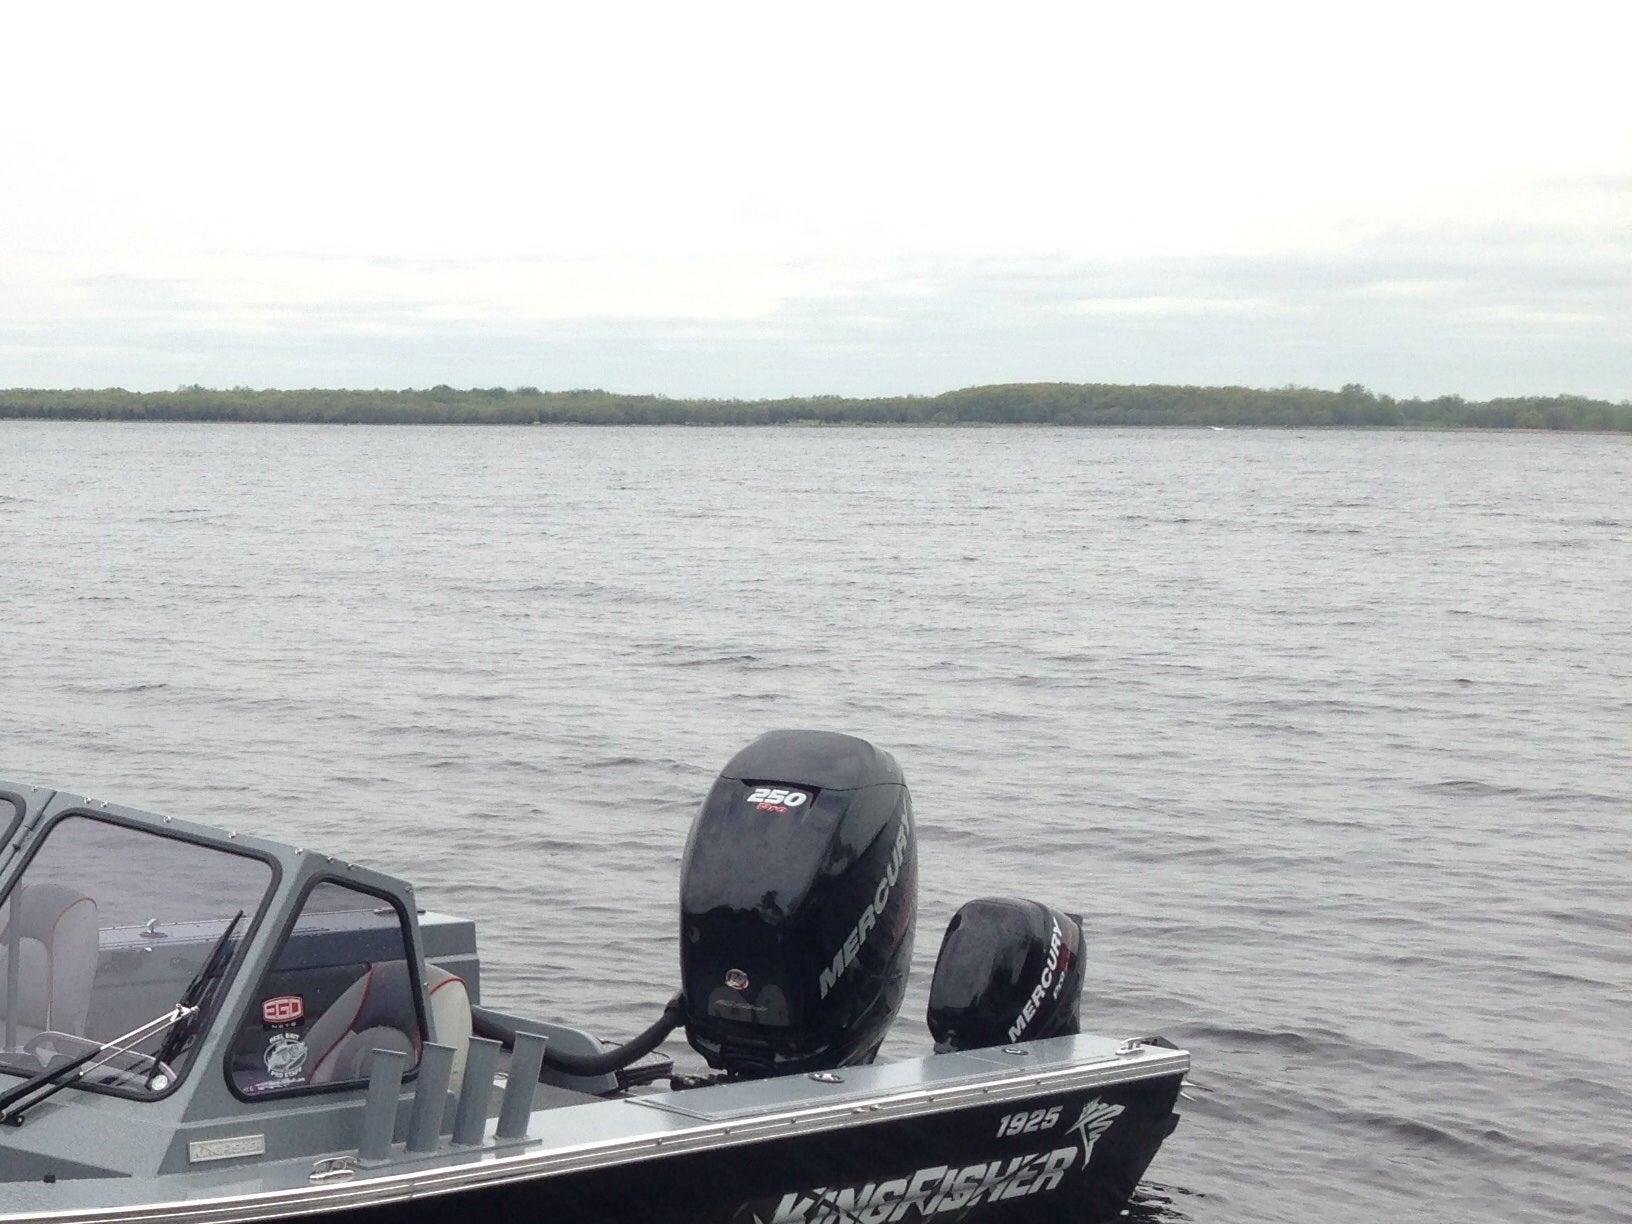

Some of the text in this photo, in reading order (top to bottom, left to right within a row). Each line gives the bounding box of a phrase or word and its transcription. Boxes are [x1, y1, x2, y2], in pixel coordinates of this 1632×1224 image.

[747, 788, 807, 807] 250
[819, 797, 910, 1001] MERCURY
[1008, 916, 1062, 1043] MERCURY
[996, 1105, 1063, 1137] 1925
